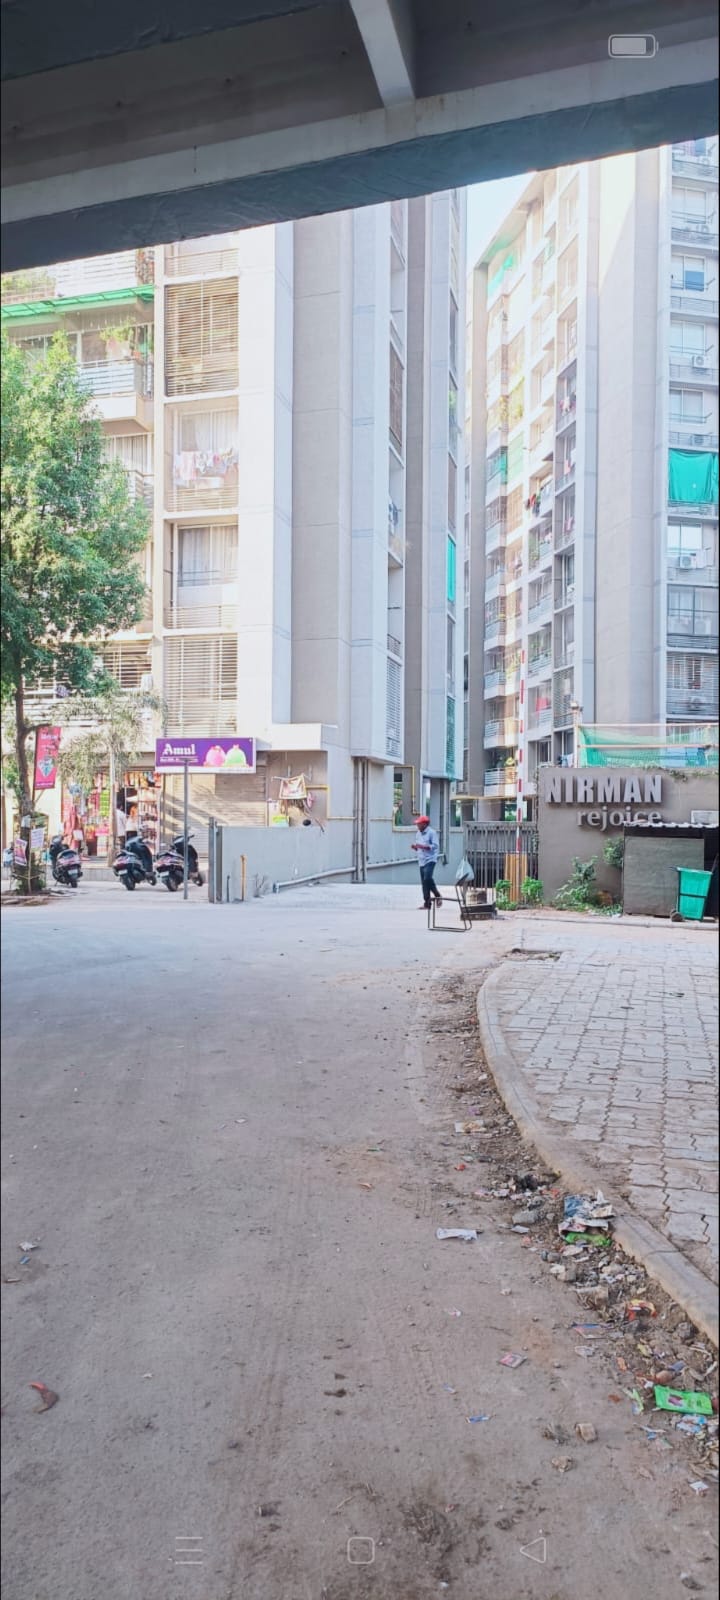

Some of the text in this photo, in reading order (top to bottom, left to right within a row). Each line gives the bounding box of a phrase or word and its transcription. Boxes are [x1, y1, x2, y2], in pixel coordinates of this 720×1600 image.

[162, 743, 196, 756] Amul
[545, 774, 662, 803] NIRMAN
[576, 805, 662, 832] rejoice
